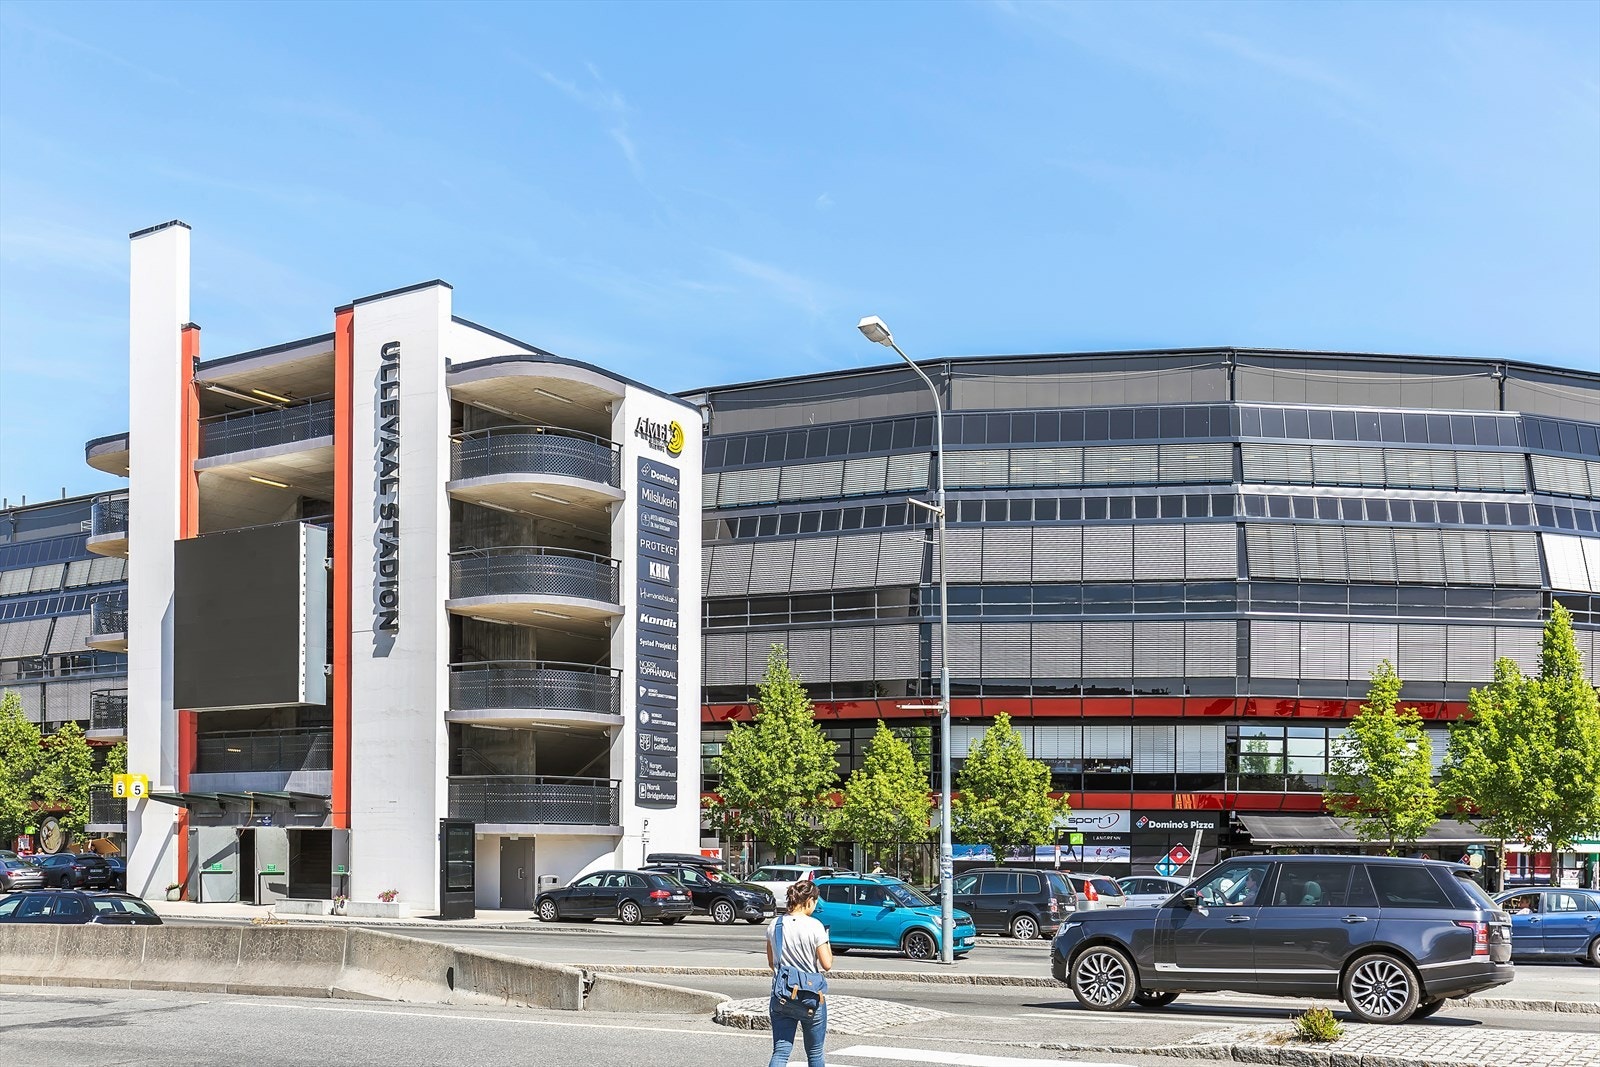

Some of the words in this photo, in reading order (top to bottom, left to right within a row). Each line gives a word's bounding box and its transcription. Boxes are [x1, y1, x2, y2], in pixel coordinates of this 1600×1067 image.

[380, 340, 401, 496] ULLEVAAL
[650, 469, 678, 486] Domino's
[640, 538, 678, 557] PROTEKET
[379, 502, 400, 632] STADION
[649, 561, 671, 580] KRIK
[639, 612, 678, 629] Kondis
[639, 660, 657, 669] NORSK
[653, 735, 669, 744] Norges
[649, 762, 663, 771] Norges
[117, 785, 123, 795] 5
[134, 785, 141, 795] 5
[646, 783, 661, 791] Norsk
[643, 819, 649, 830] P
[1067, 816, 1103, 825] sport
[1149, 820, 1189, 829] Domino's
[1190, 820, 1215, 829] Pizza
